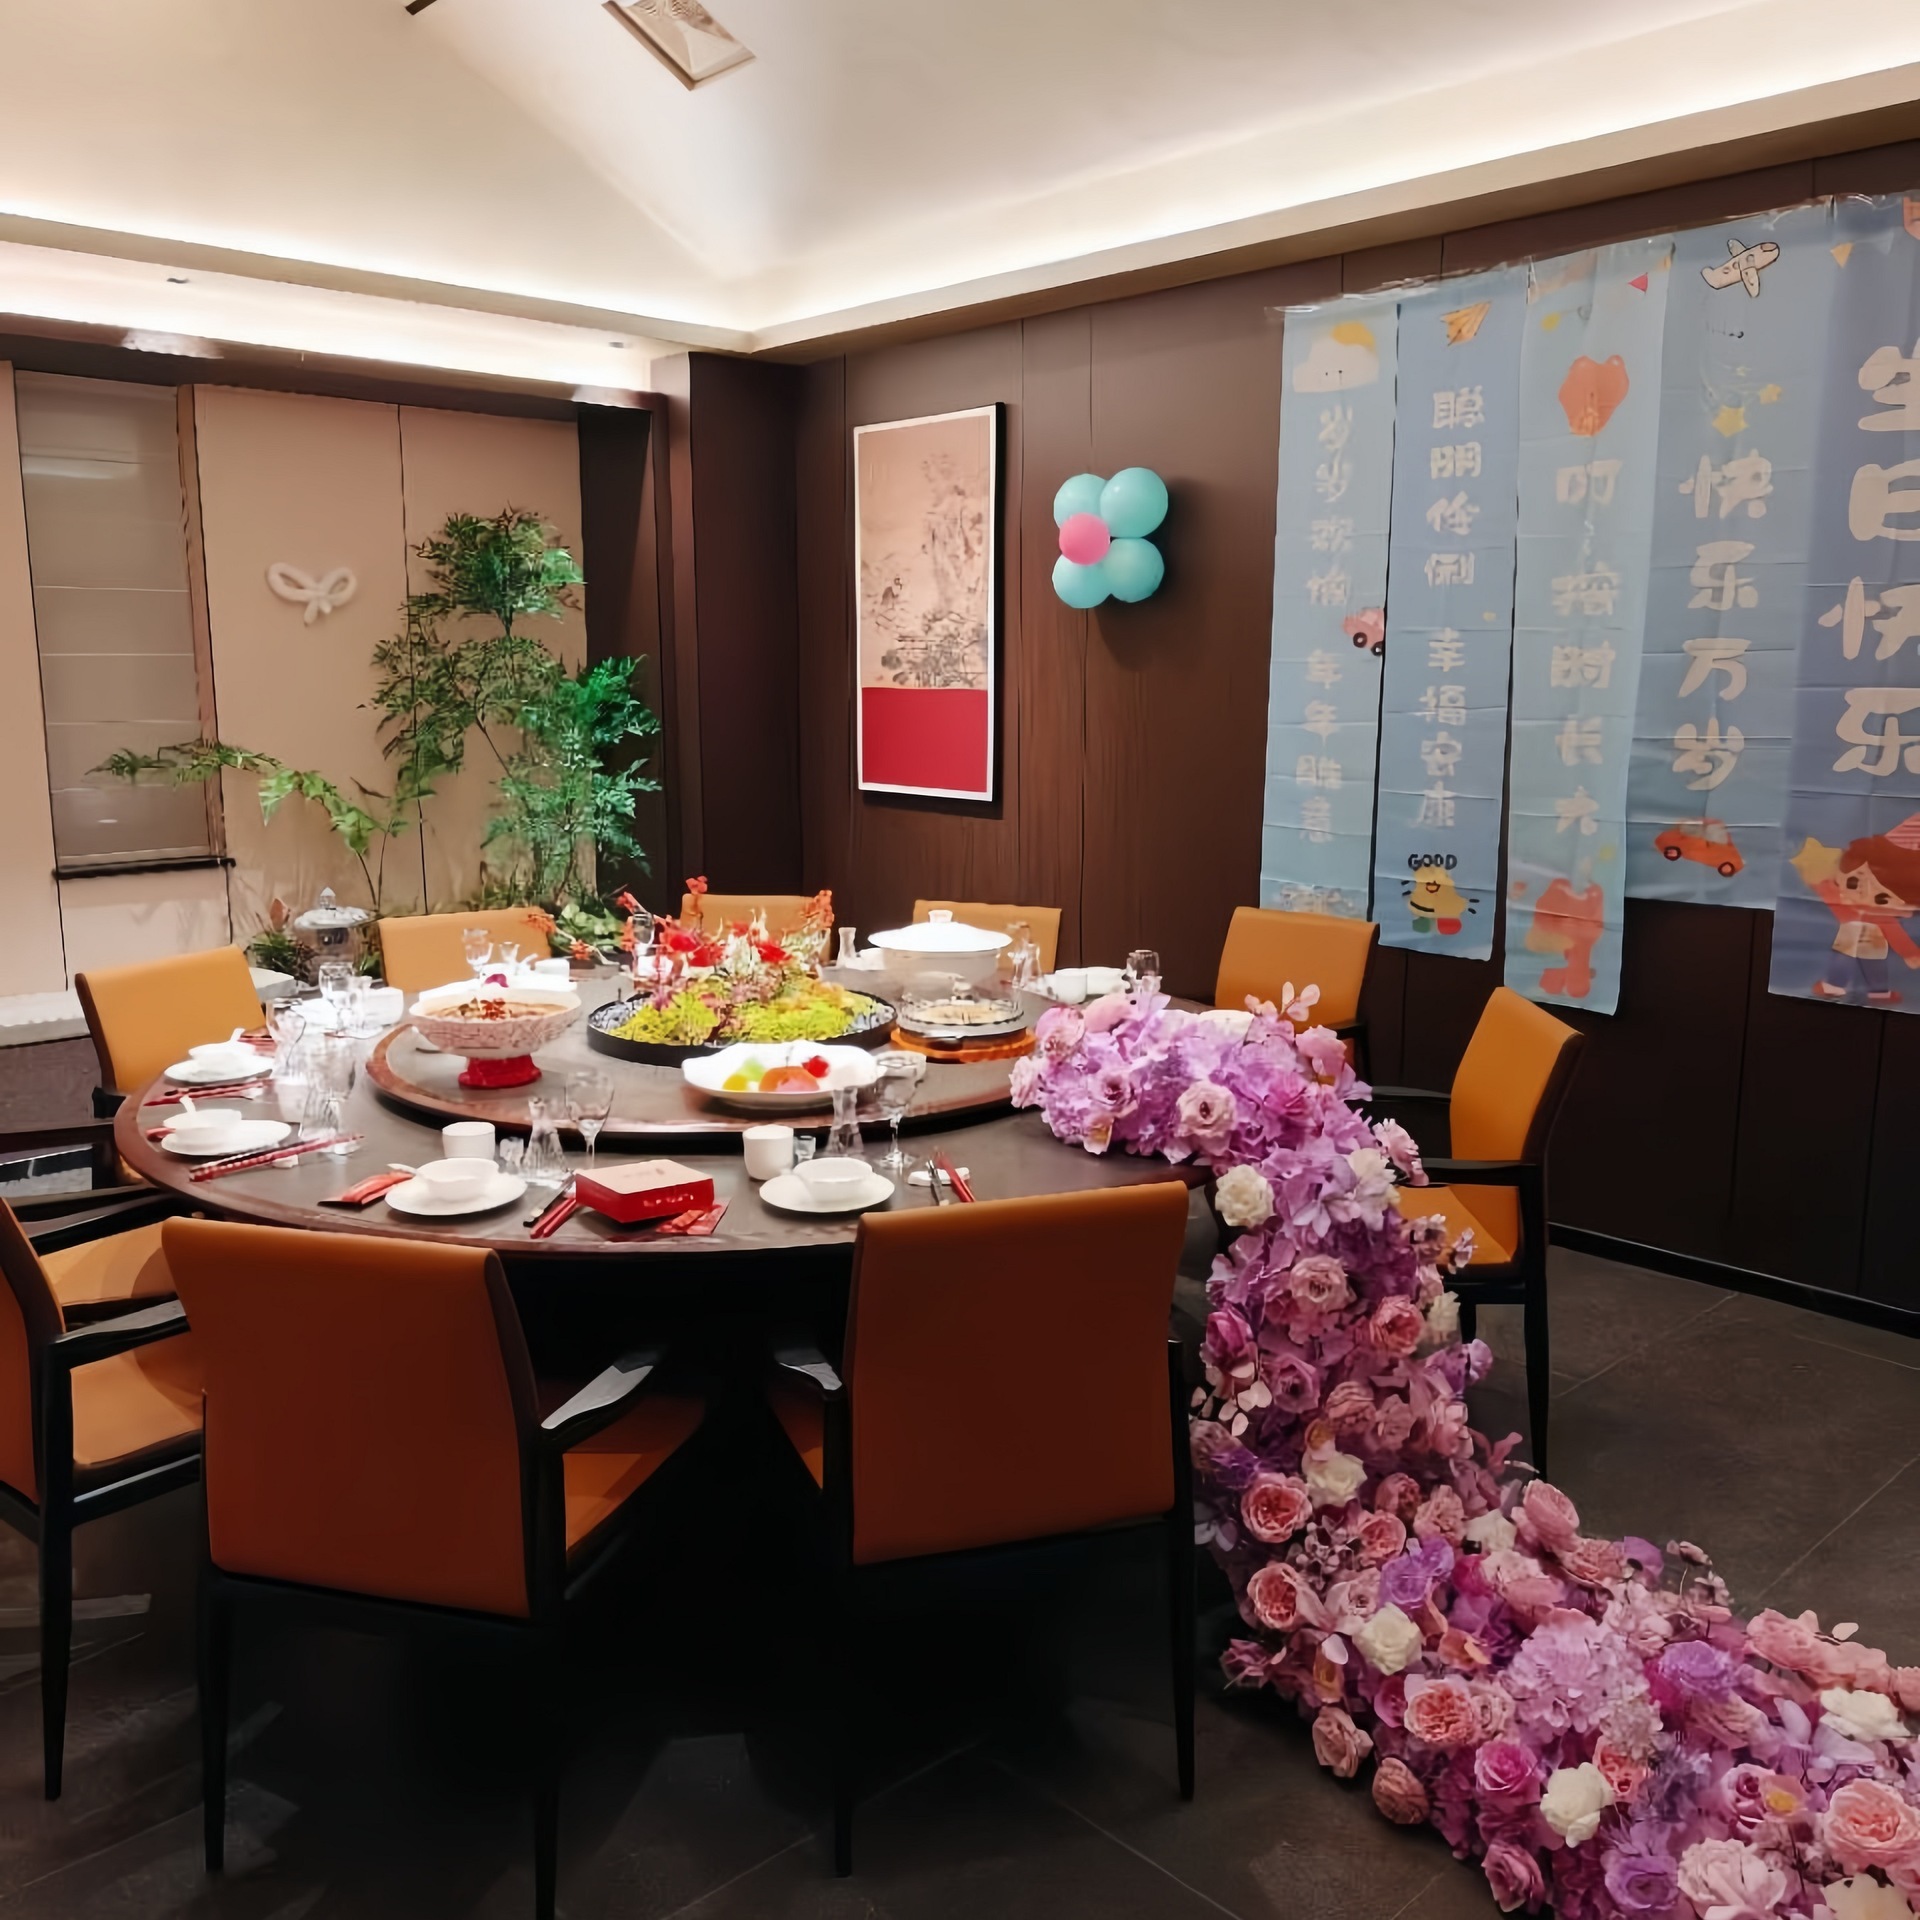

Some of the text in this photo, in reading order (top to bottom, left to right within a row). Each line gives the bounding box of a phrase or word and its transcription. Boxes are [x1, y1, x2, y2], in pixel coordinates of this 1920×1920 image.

[1412, 385, 1485, 828] 聪明伶俐 幸福安康
[1673, 449, 1774, 791] 快乐万岁
[1818, 338, 1920, 776] 生日快乐
[1407, 853, 1458, 871] GOOD
